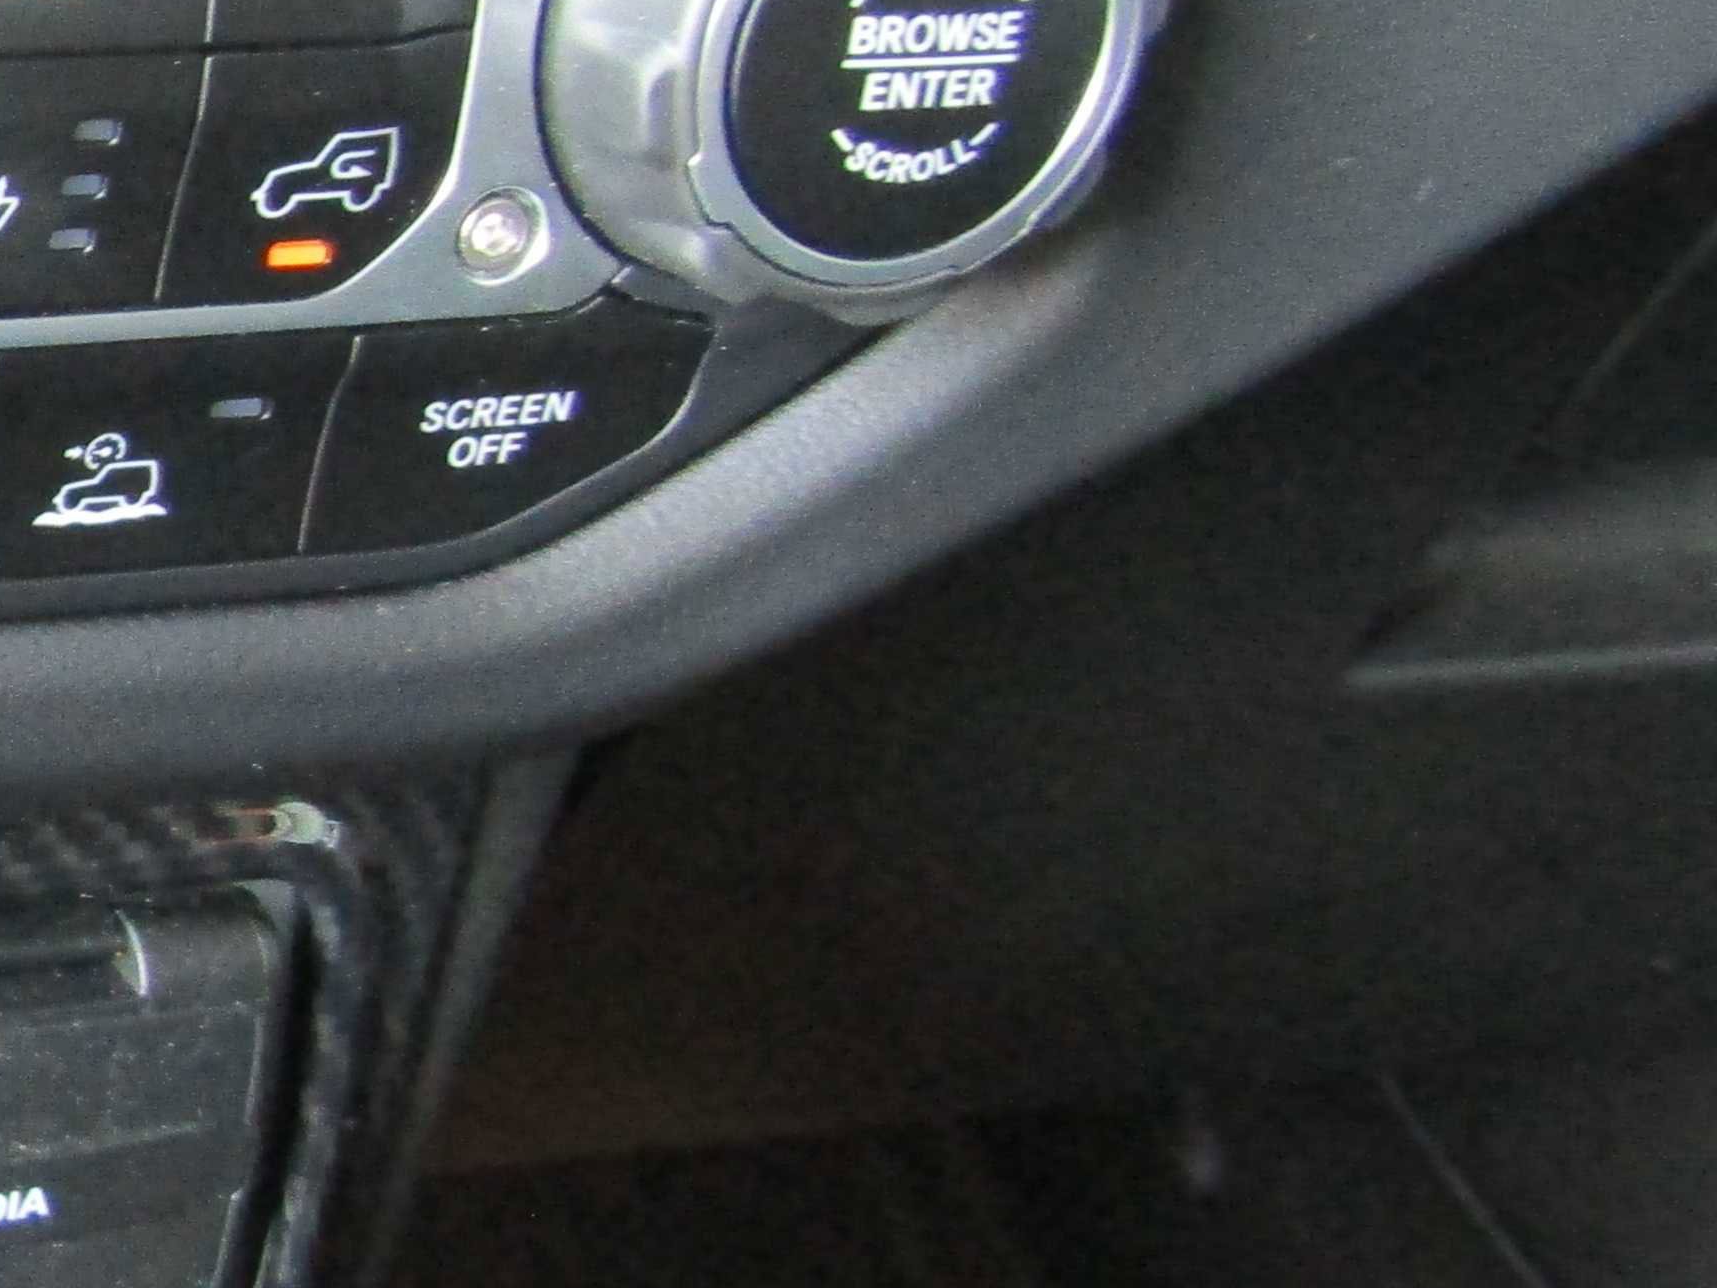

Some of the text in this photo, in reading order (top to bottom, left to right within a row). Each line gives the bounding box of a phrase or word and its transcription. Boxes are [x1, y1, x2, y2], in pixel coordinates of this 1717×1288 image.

[848, 10, 1025, 57] BROWSE
[859, 66, 996, 112] ENTER
[845, 141, 977, 187] SCROLL
[420, 390, 577, 435] SCREEN
[447, 432, 530, 469] OFF
